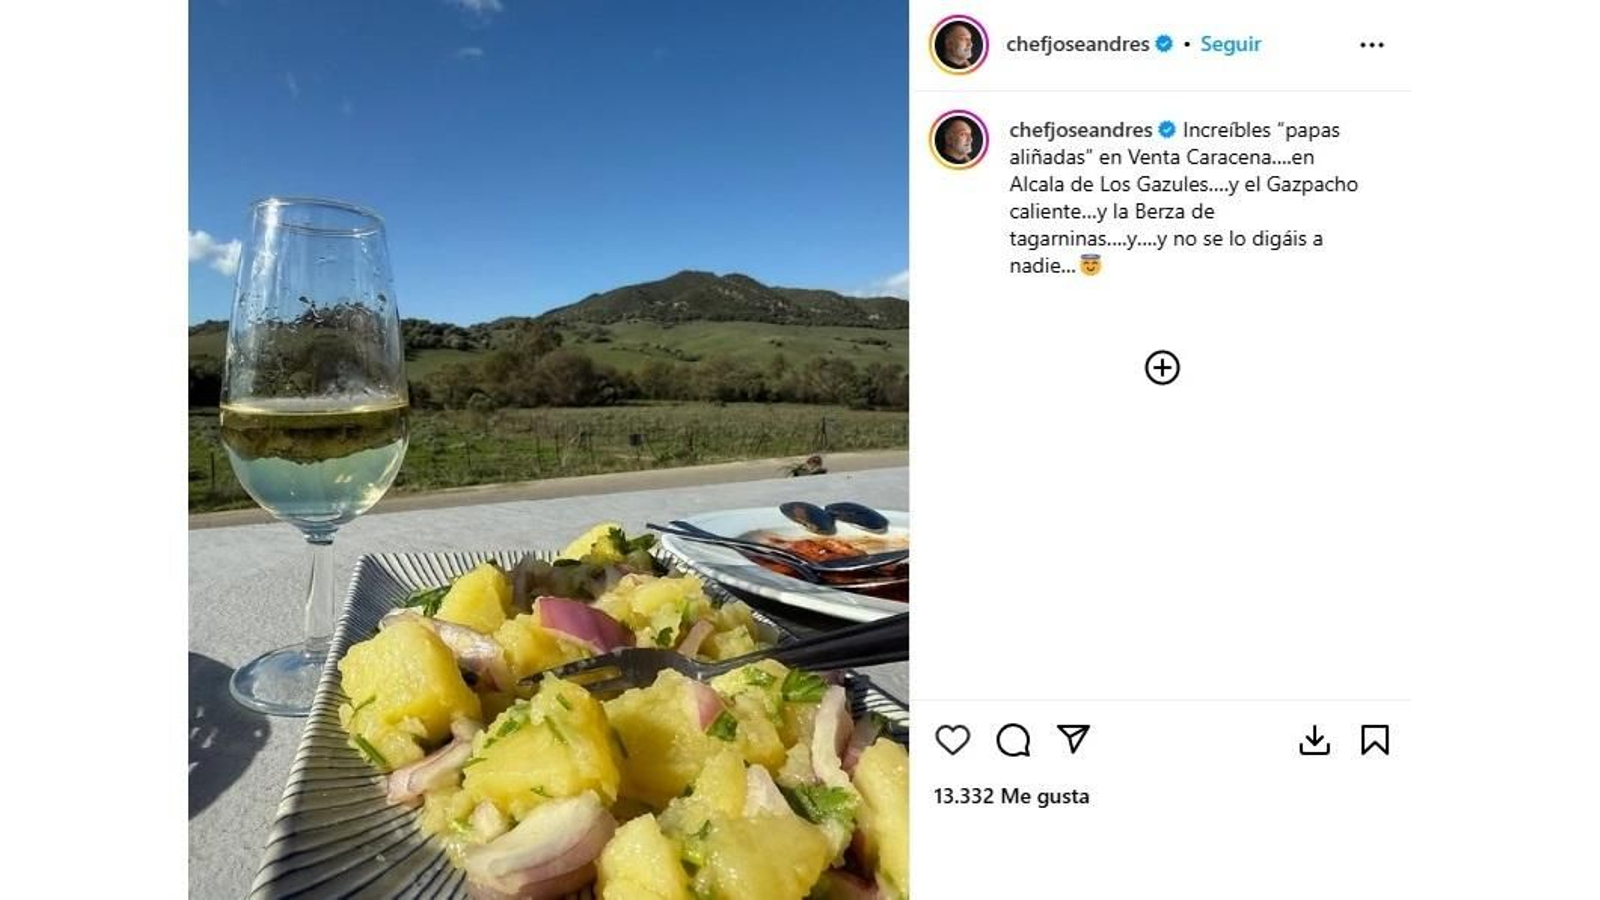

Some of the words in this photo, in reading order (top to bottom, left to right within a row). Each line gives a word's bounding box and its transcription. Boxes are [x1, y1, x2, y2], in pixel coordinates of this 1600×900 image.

[1006, 34, 1150, 56] chefjoseandres
[1201, 35, 1262, 56] Seguir
[1009, 121, 1153, 143] chefjoseandres
[1183, 121, 1271, 138] Increíbles
[1099, 152, 1122, 166] en
[1128, 148, 1181, 166] Venta
[1009, 175, 1065, 193] Alcala
[1070, 175, 1094, 193] de
[1100, 176, 1131, 193] Los
[1245, 175, 1261, 193] el
[1267, 175, 1359, 197] Gazpacho
[1113, 202, 1129, 220] la
[1136, 203, 1186, 220] Berza
[1191, 202, 1216, 220] de
[1174, 233, 1198, 247] no
[1203, 233, 1224, 247] se
[1229, 229, 1247, 247] lo
[1252, 229, 1308, 251] digáis
[1312, 234, 1324, 247] a
[933, 787, 995, 805] 13.332
[1001, 787, 1032, 805] Me
[1037, 789, 1090, 809] gusta
